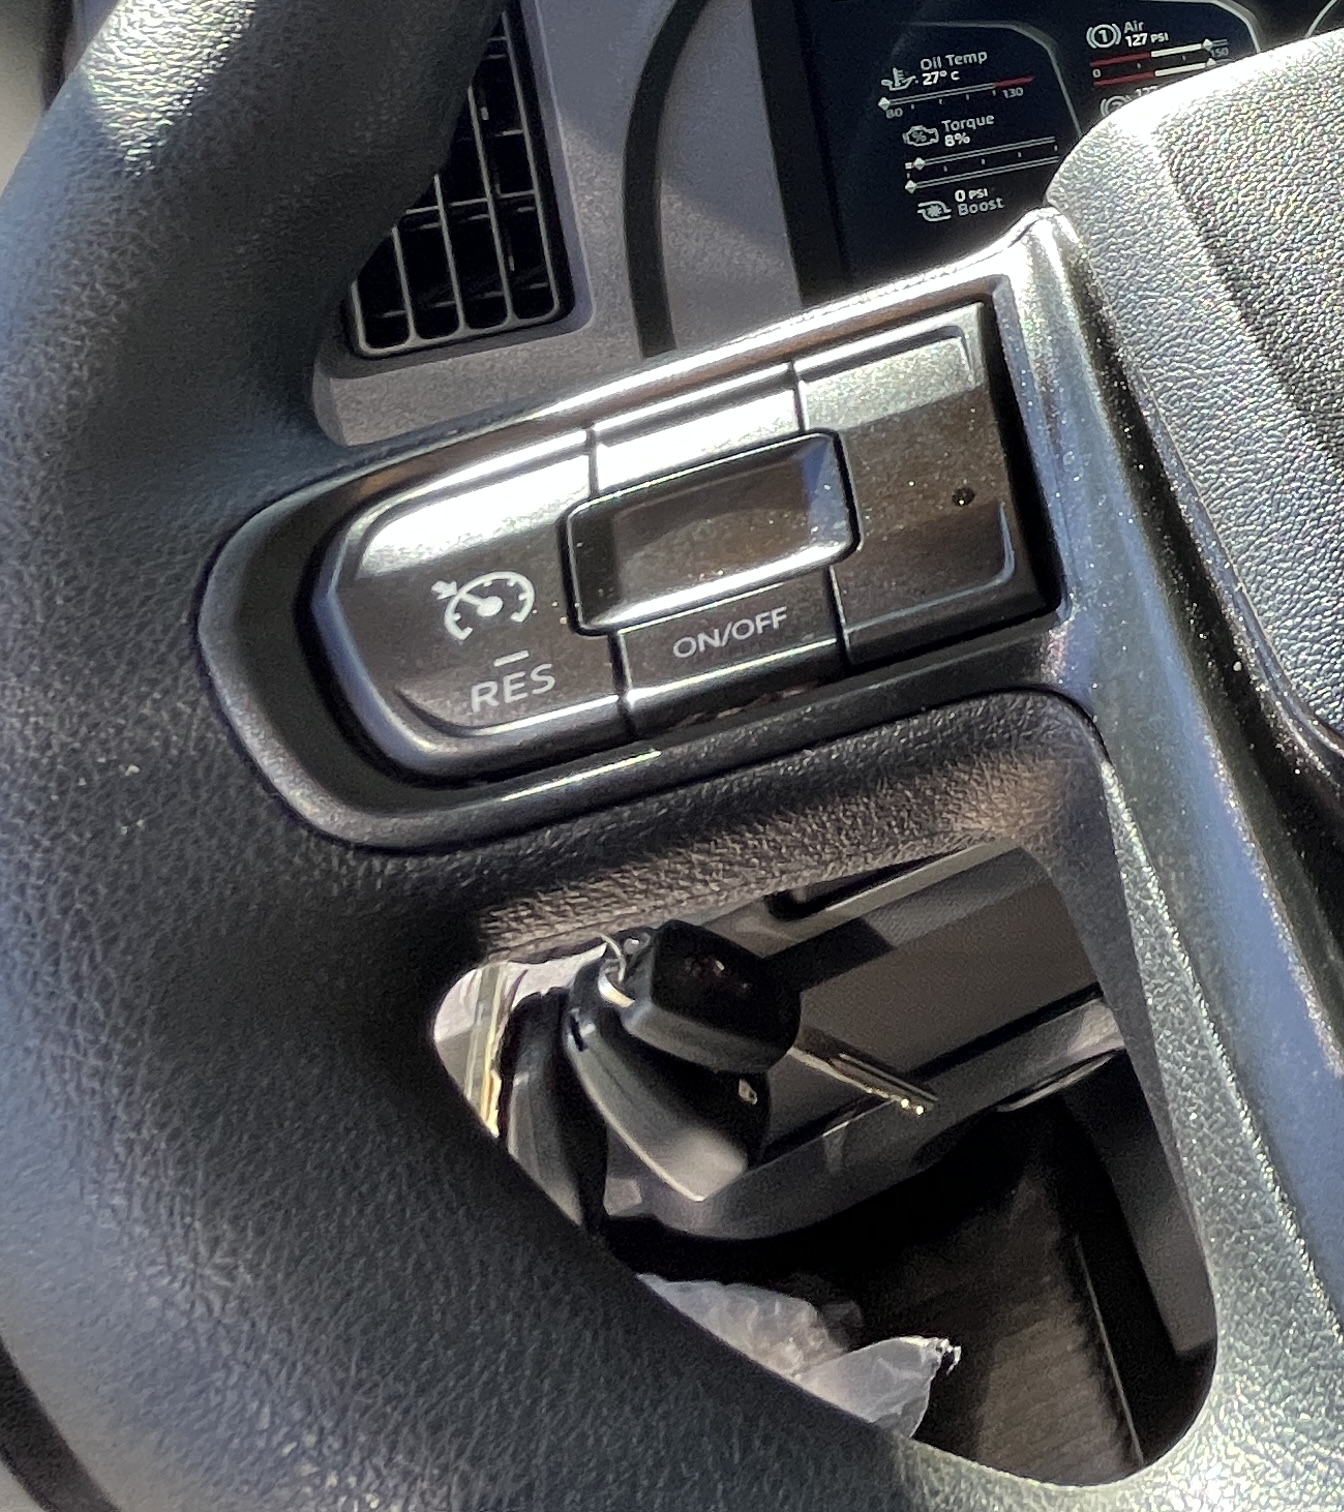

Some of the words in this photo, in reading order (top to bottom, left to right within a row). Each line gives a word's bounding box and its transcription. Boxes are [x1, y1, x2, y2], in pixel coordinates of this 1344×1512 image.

[1122, 19, 1145, 34] Air
[1124, 32, 1148, 48] 127
[1150, 31, 1170, 44] PSI
[919, 55, 943, 72] Oil
[945, 50, 989, 67] Temp
[1001, 86, 1026, 100] 130
[940, 114, 996, 134] Torque
[943, 134, 971, 148] 8%
[953, 189, 967, 203] 0
[968, 187, 989, 201] PSI
[957, 197, 1006, 217] Boost
[671, 606, 789, 660] ON/OFF
[470, 662, 557, 714] RES
